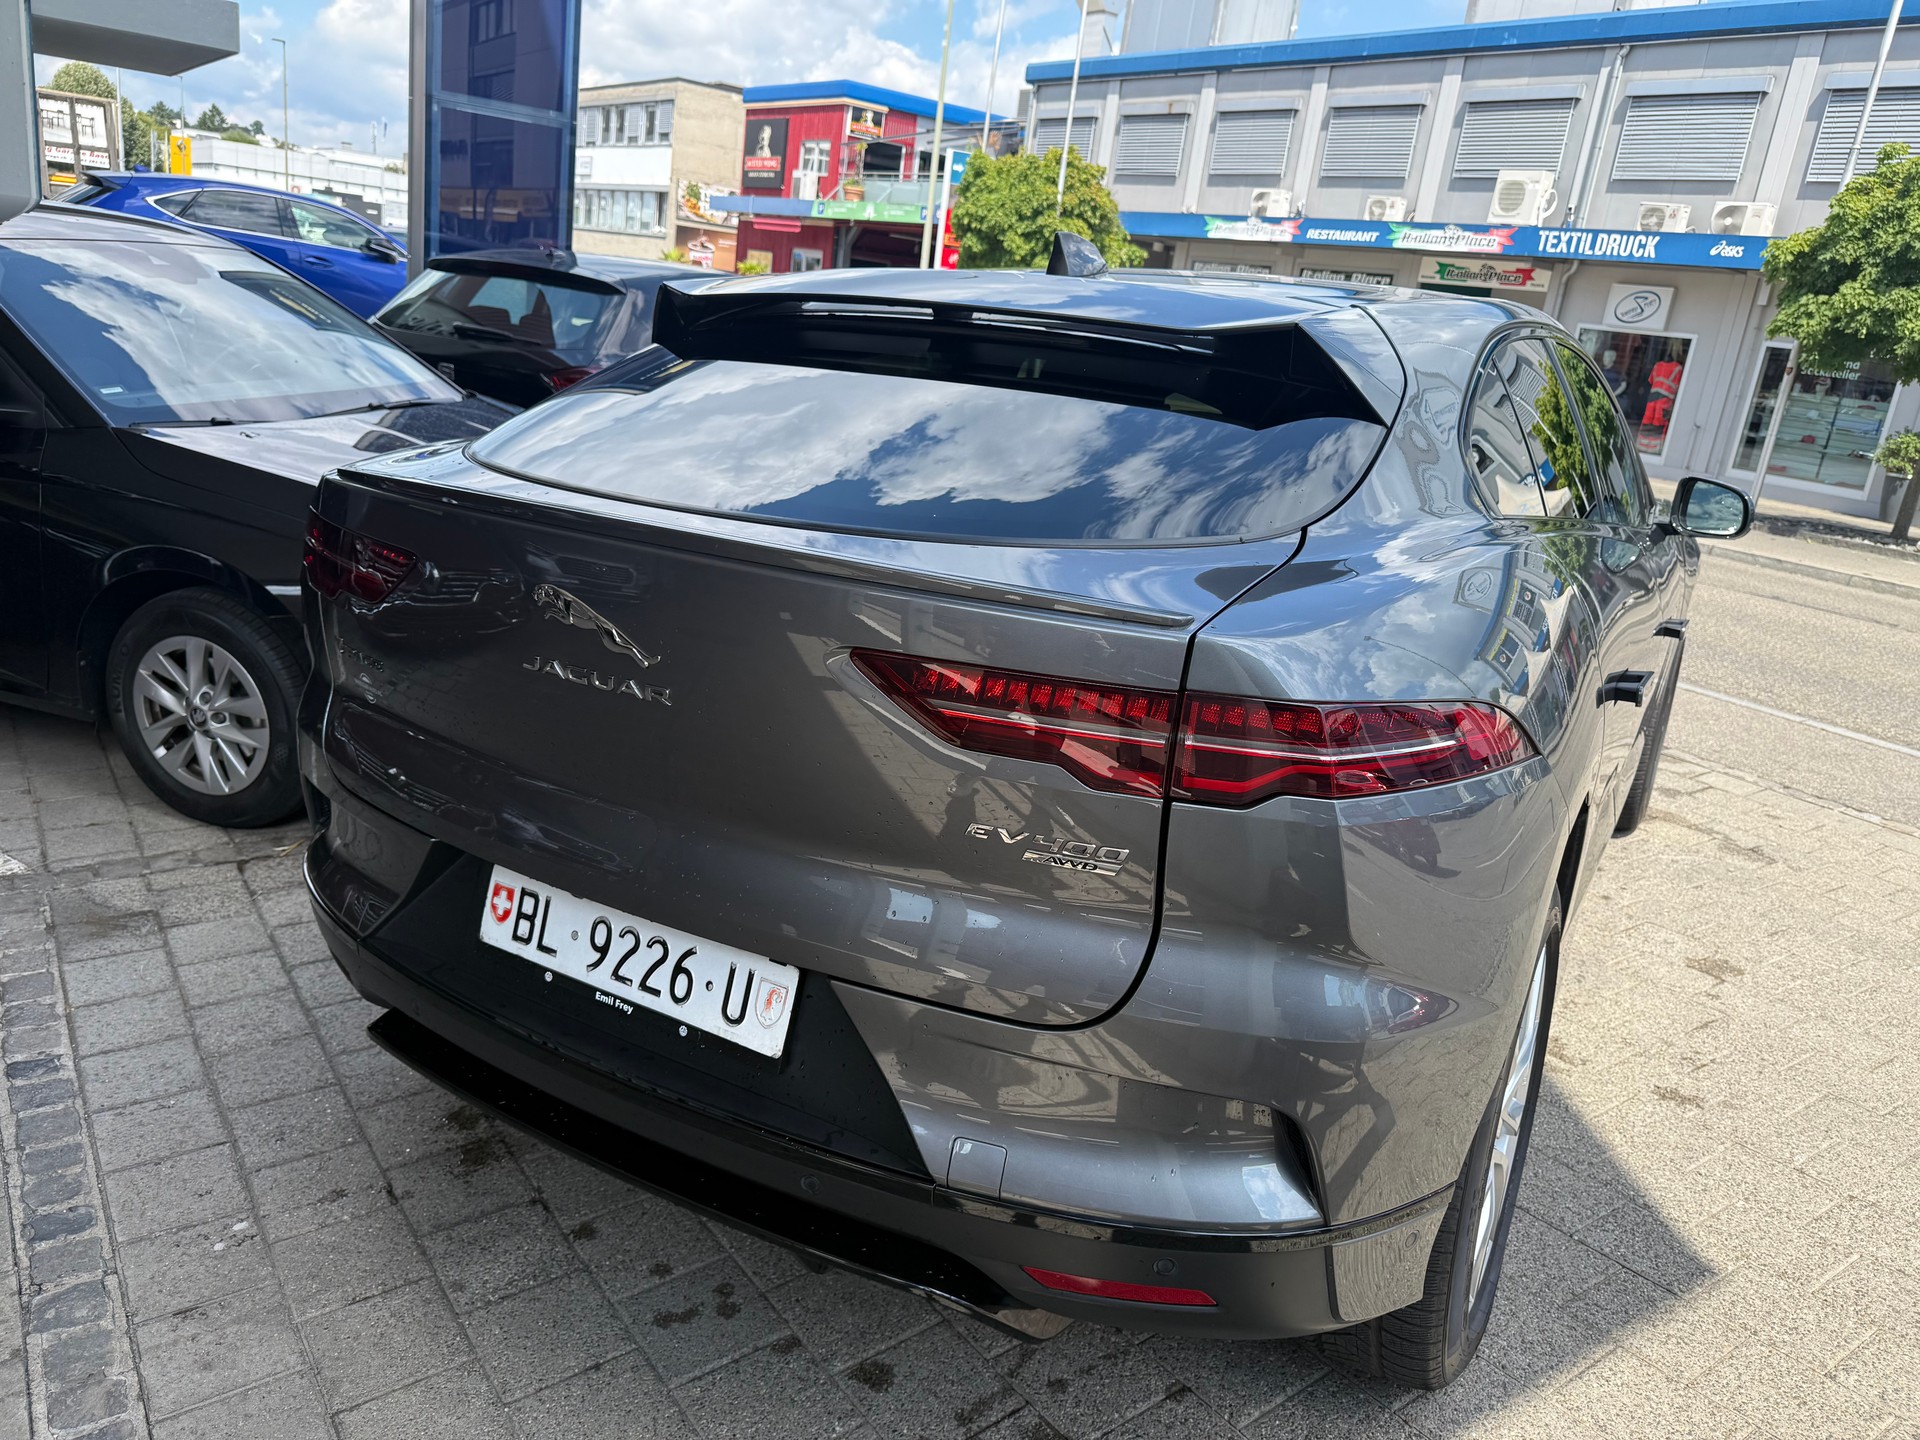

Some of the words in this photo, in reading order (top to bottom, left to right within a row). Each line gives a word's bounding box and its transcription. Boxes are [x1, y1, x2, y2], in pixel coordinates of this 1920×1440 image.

[1306, 229, 1380, 243] RESTAURANT
[1401, 232, 1450, 247] Italian
[1454, 233, 1497, 249] Place
[1538, 230, 1661, 259] TEXTILDRUCK
[1446, 268, 1484, 282] Italian
[1487, 271, 1522, 284] Place
[522, 656, 672, 706] JAGUAR
[1042, 856, 1098, 872] AWD
[511, 886, 557, 957] BL
[586, 915, 698, 1006] 9226
[721, 960, 757, 1028] U
[595, 990, 614, 1006] Emil
[615, 997, 634, 1014] Frey
